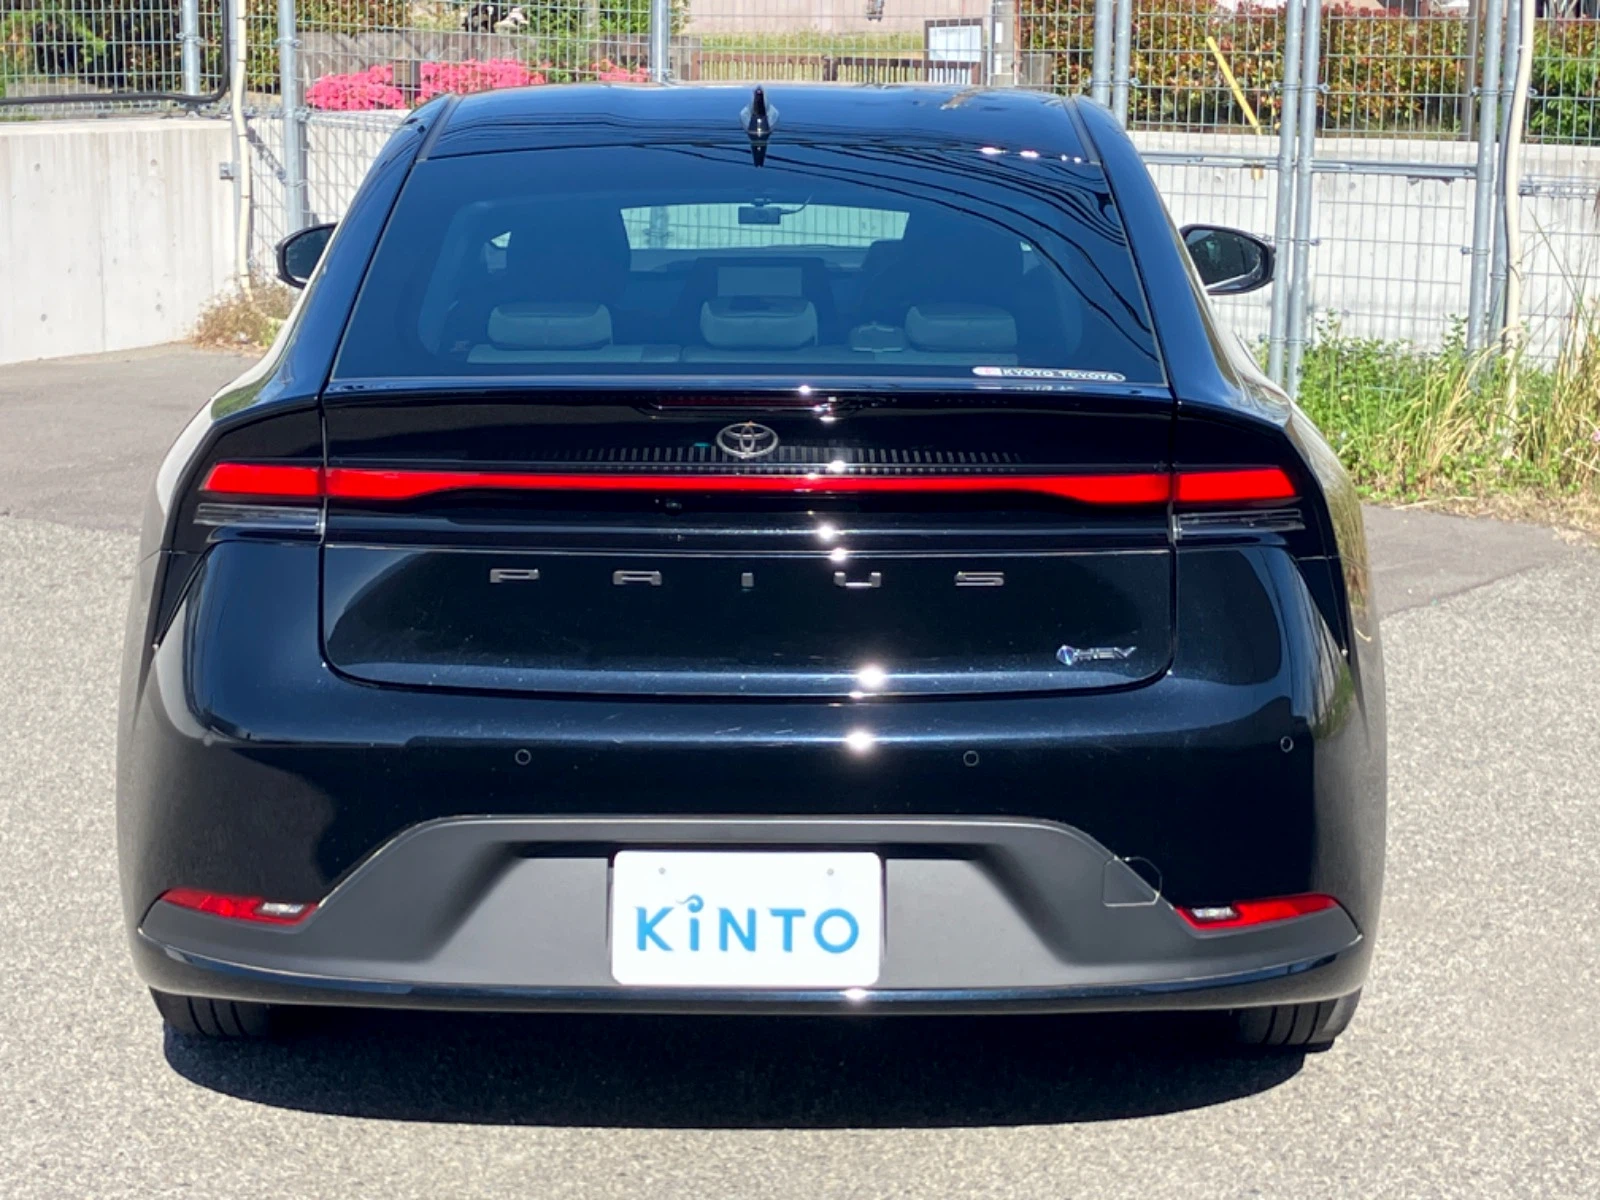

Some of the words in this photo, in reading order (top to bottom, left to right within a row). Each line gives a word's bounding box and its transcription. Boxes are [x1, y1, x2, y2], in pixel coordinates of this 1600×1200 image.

[1002, 368, 1053, 377] KYOTO
[1060, 370, 1117, 381] TOYOTA
[489, 568, 1005, 588] PRIUS
